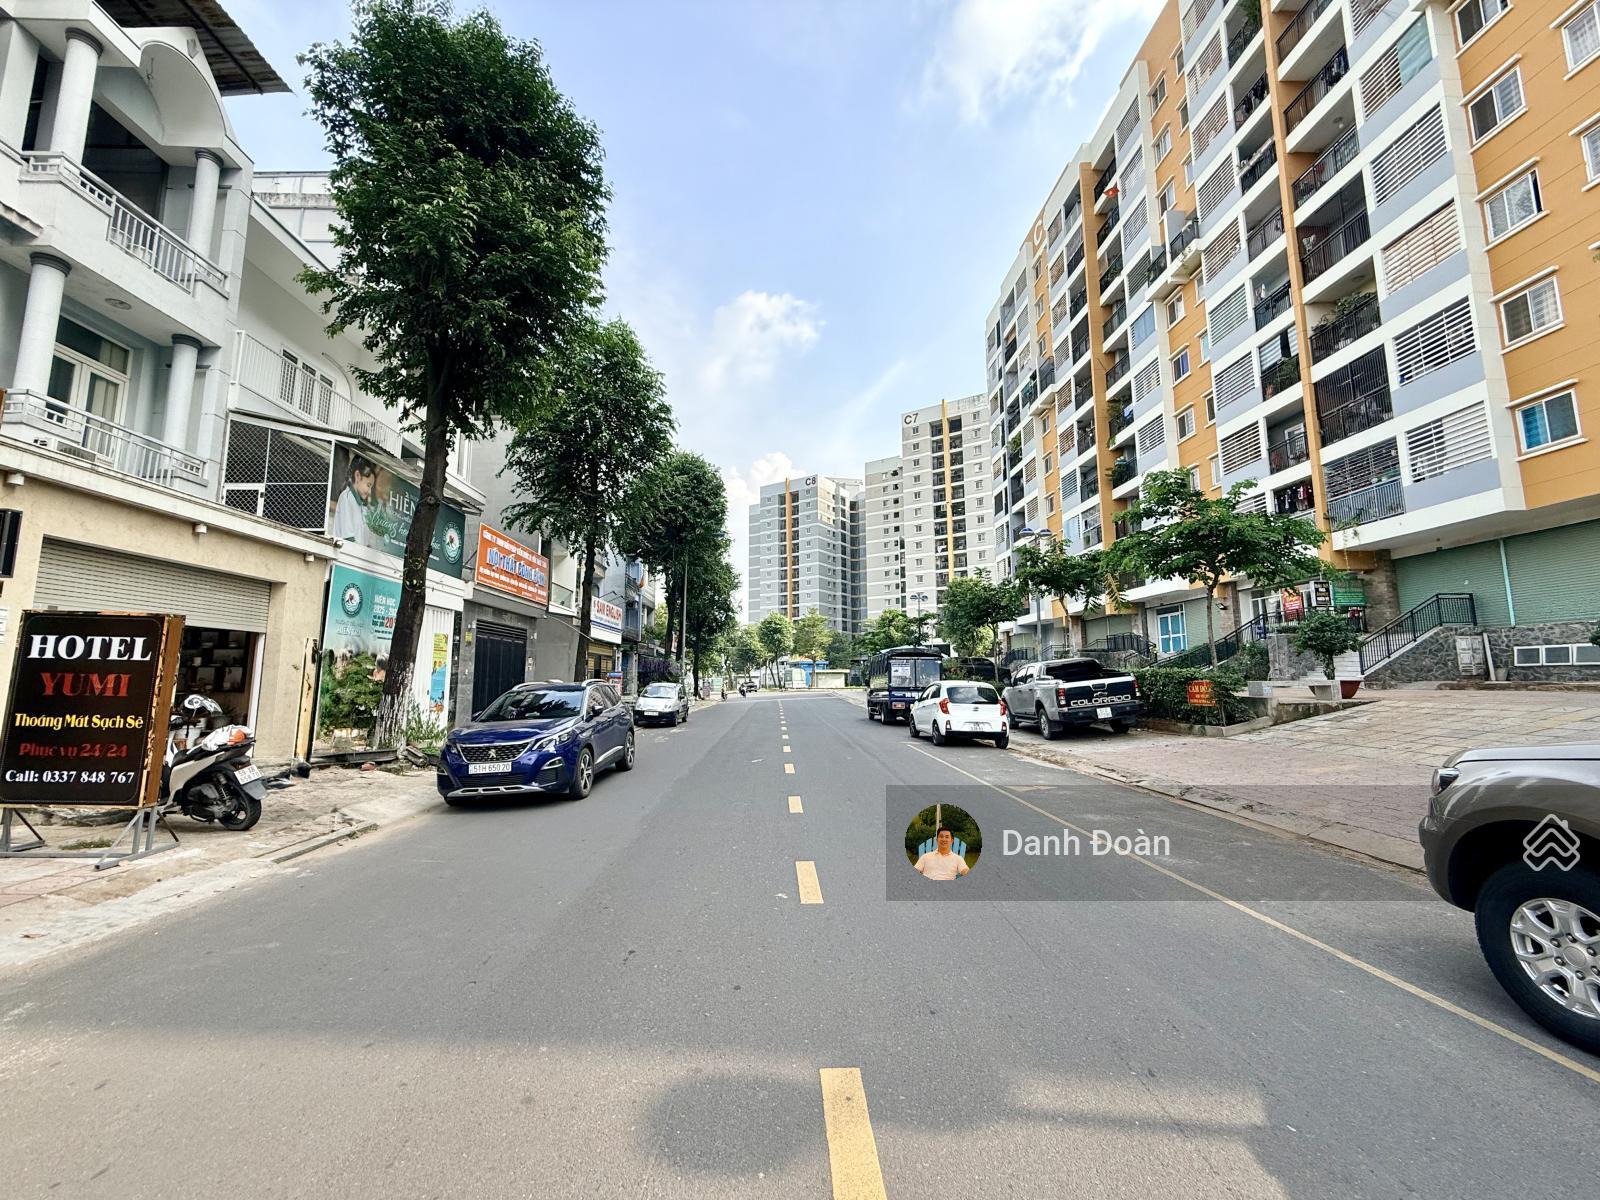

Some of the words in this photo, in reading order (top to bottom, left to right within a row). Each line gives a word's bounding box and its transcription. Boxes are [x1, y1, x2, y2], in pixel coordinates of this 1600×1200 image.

[903, 412, 919, 425] C7
[805, 475, 817, 486] C8
[27, 634, 152, 661] HOTEL
[41, 672, 132, 697] YUMI
[1070, 694, 1131, 707] COLORADO
[15, 713, 62, 731] Thoáng
[64, 714, 89, 728] Mát
[91, 714, 124, 731] Sạch
[473, 764, 487, 773] 51H
[5, 769, 39, 783] Call:
[43, 770, 77, 783] 0337
[80, 771, 106, 784] 848
[110, 771, 135, 784] 767
